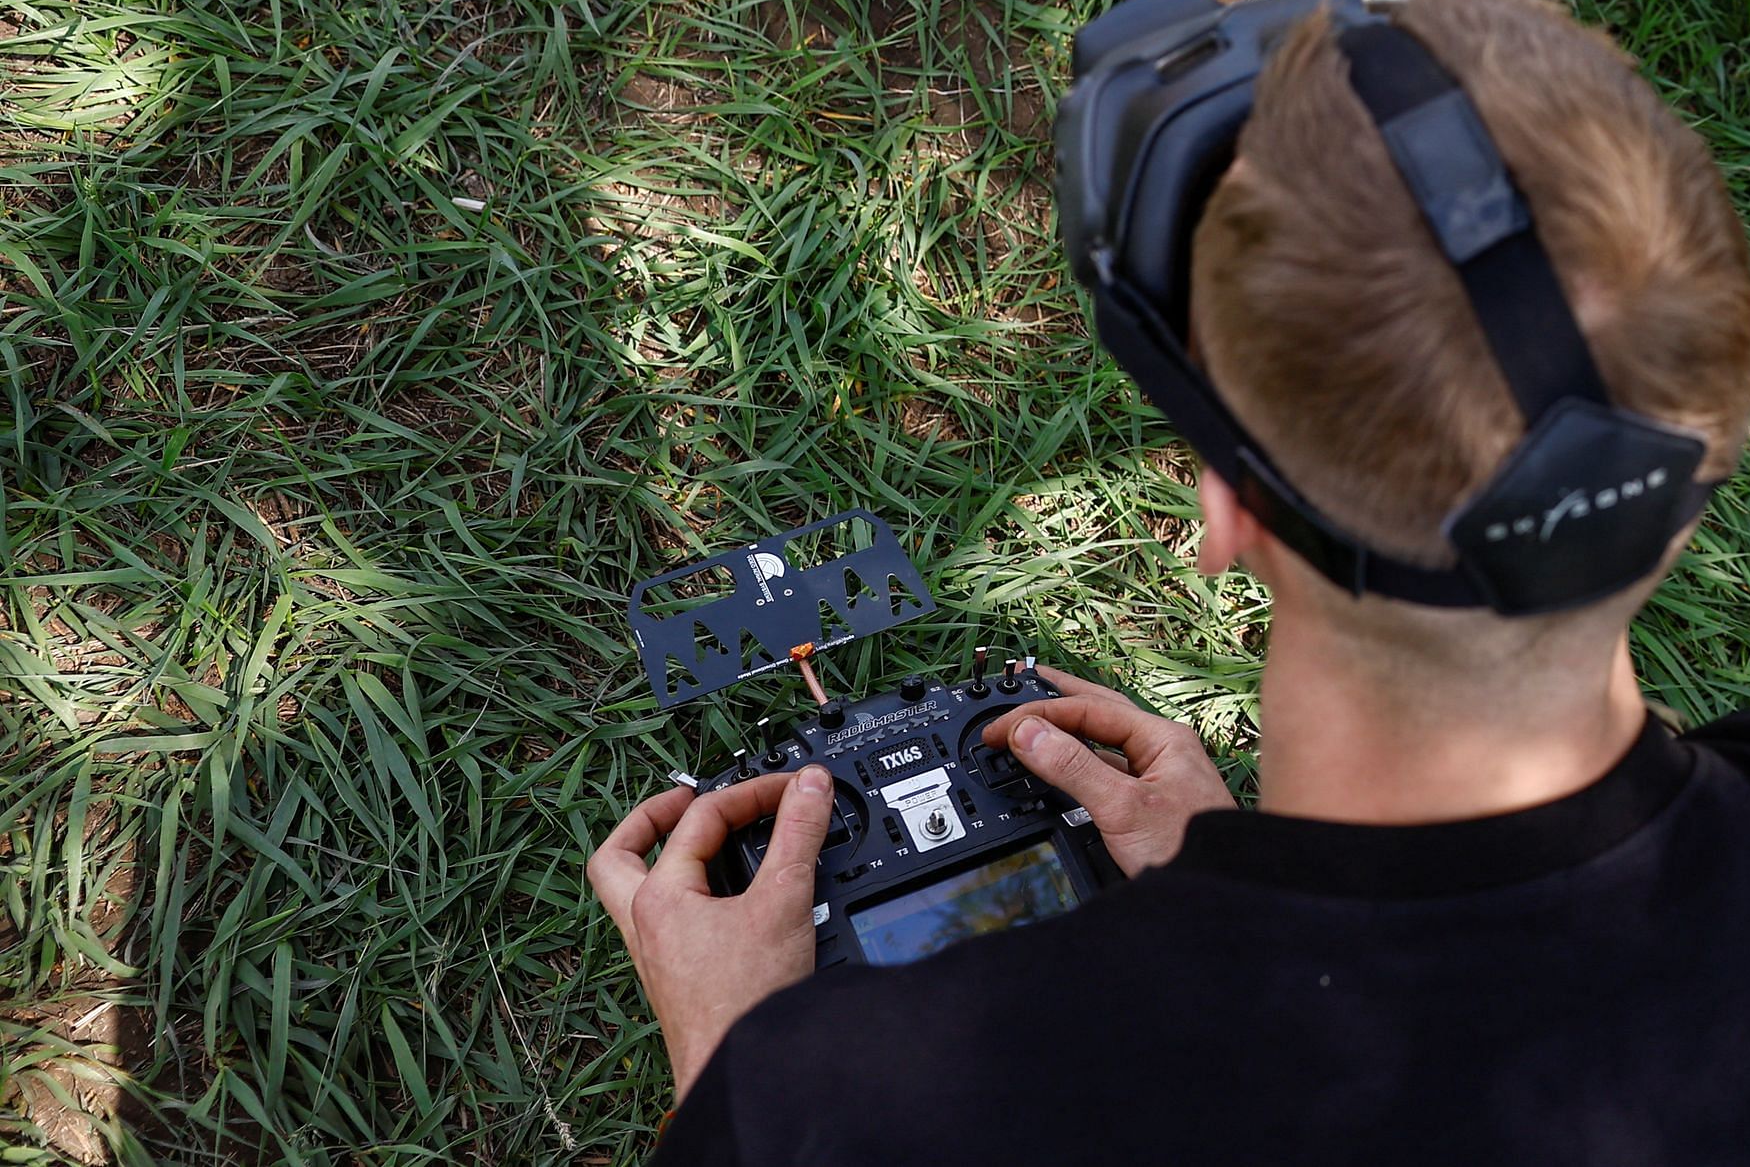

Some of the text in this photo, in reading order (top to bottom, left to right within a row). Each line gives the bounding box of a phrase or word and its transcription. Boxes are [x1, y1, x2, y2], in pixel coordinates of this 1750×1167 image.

[827, 700, 937, 744] RADIOMASTER
[805, 727, 817, 735] S1
[879, 745, 923, 771] TX16S
[944, 762, 956, 770] T6
[866, 789, 879, 798] T5
[904, 790, 938, 807] POWER
[998, 813, 1010, 821] T1
[971, 821, 984, 829] T2
[896, 848, 909, 857] T3
[870, 859, 883, 869] T4
